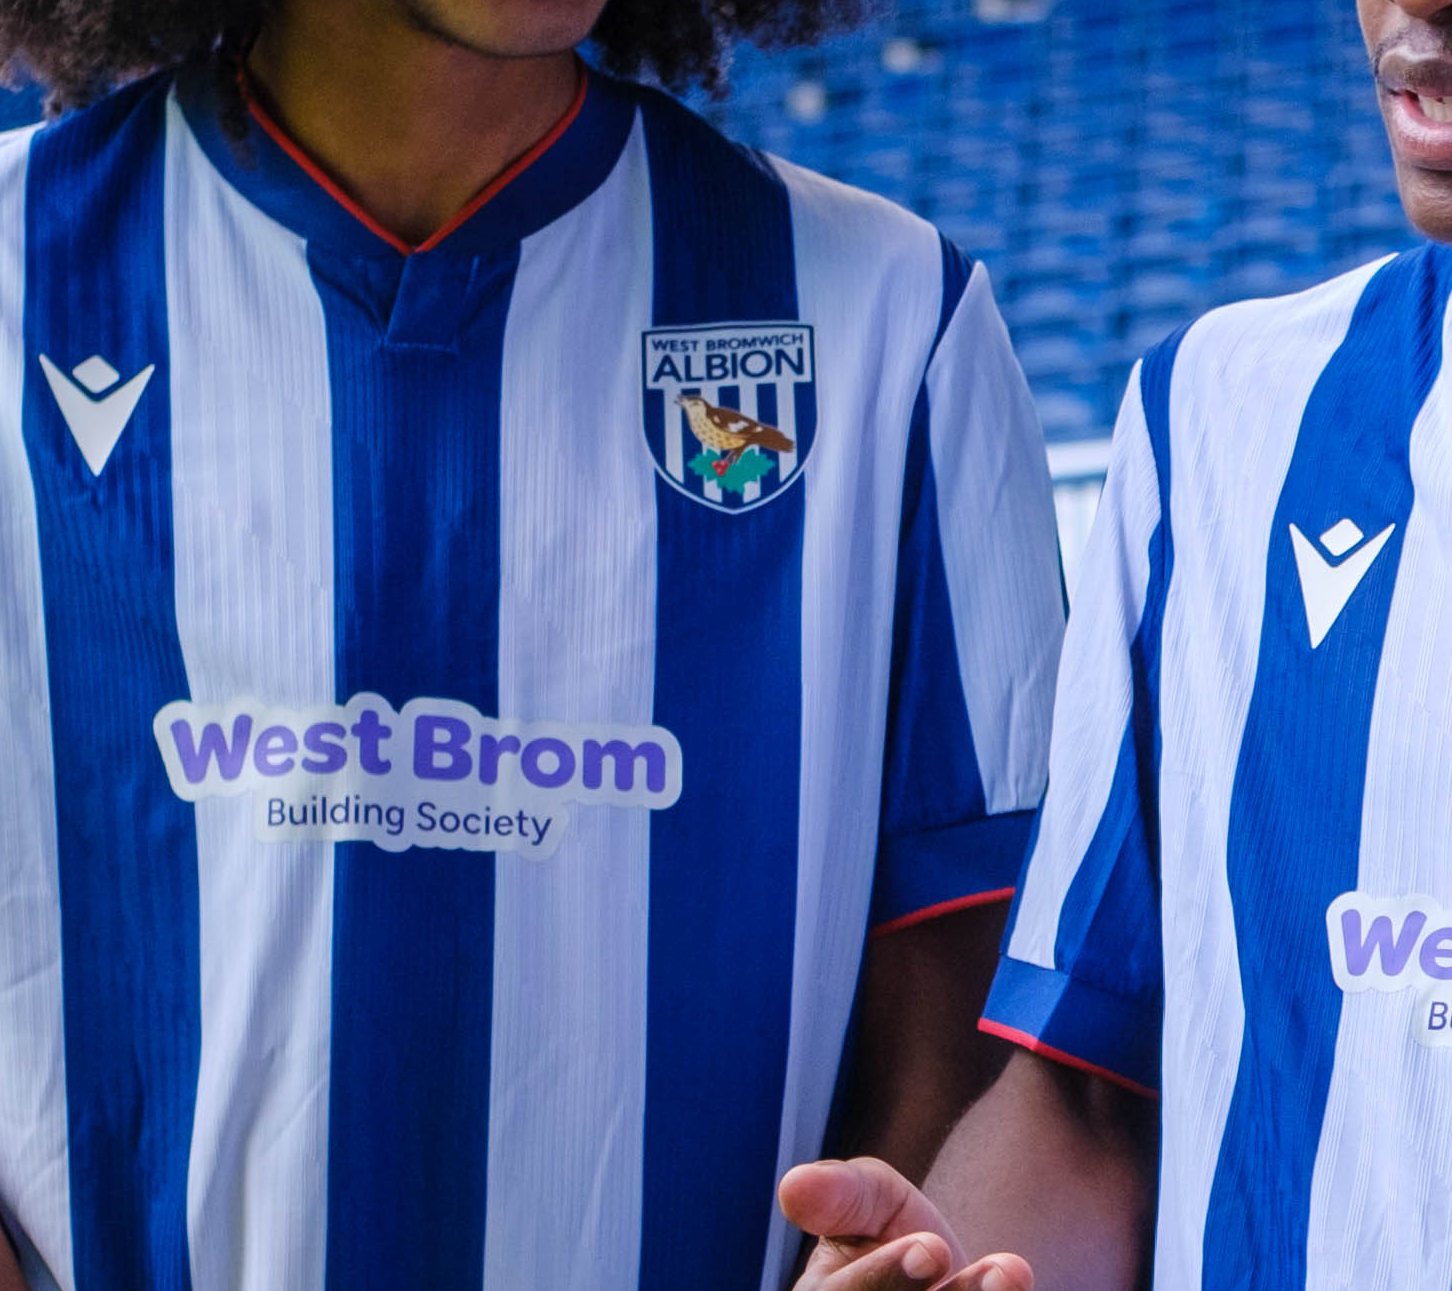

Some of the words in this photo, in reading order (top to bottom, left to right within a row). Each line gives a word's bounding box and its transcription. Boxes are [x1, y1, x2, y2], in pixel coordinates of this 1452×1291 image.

[651, 338, 700, 353] WEST
[706, 332, 804, 351] BROMWICH
[652, 346, 804, 383] ALBION
[170, 709, 392, 784] West
[413, 713, 666, 794] Brom
[267, 794, 405, 836] Building
[416, 801, 553, 846] Society
